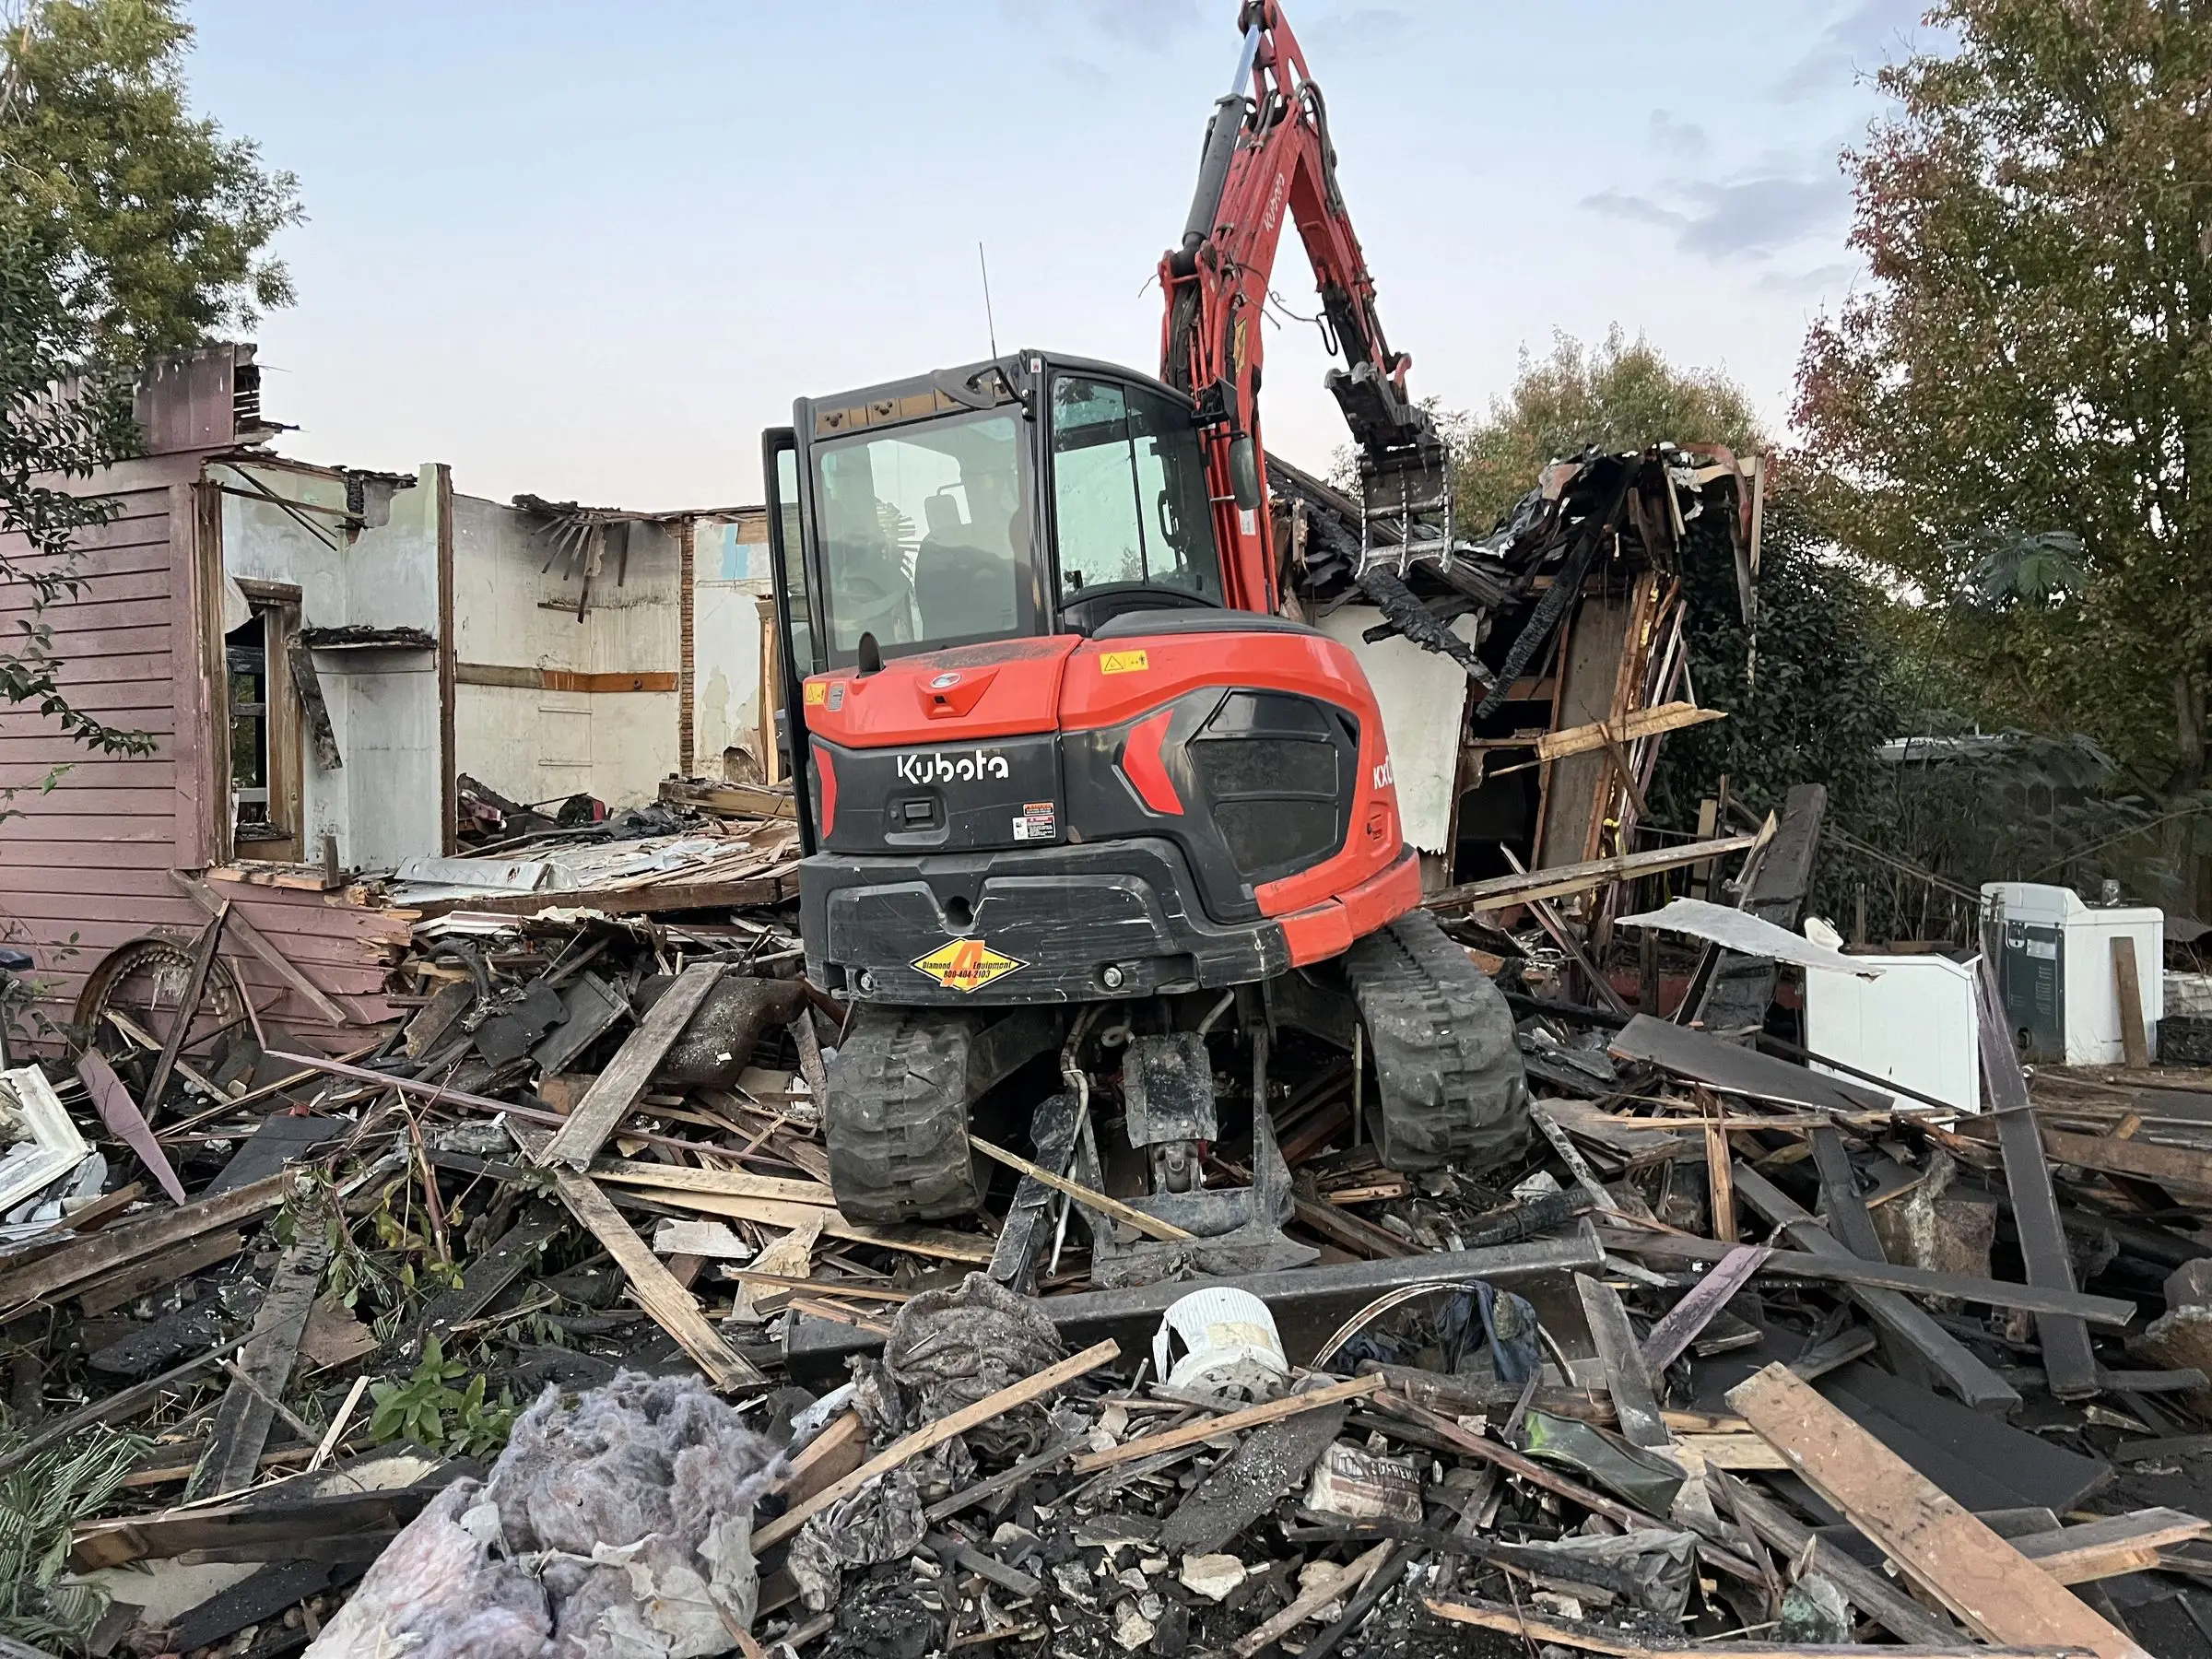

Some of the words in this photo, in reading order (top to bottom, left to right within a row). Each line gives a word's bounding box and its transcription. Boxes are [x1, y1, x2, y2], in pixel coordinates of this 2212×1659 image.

[897, 749, 1009, 784] Kubota
[923, 961, 951, 970] Diamond
[973, 961, 1012, 971] Equipment
[944, 970, 991, 979] 800-404-2103
